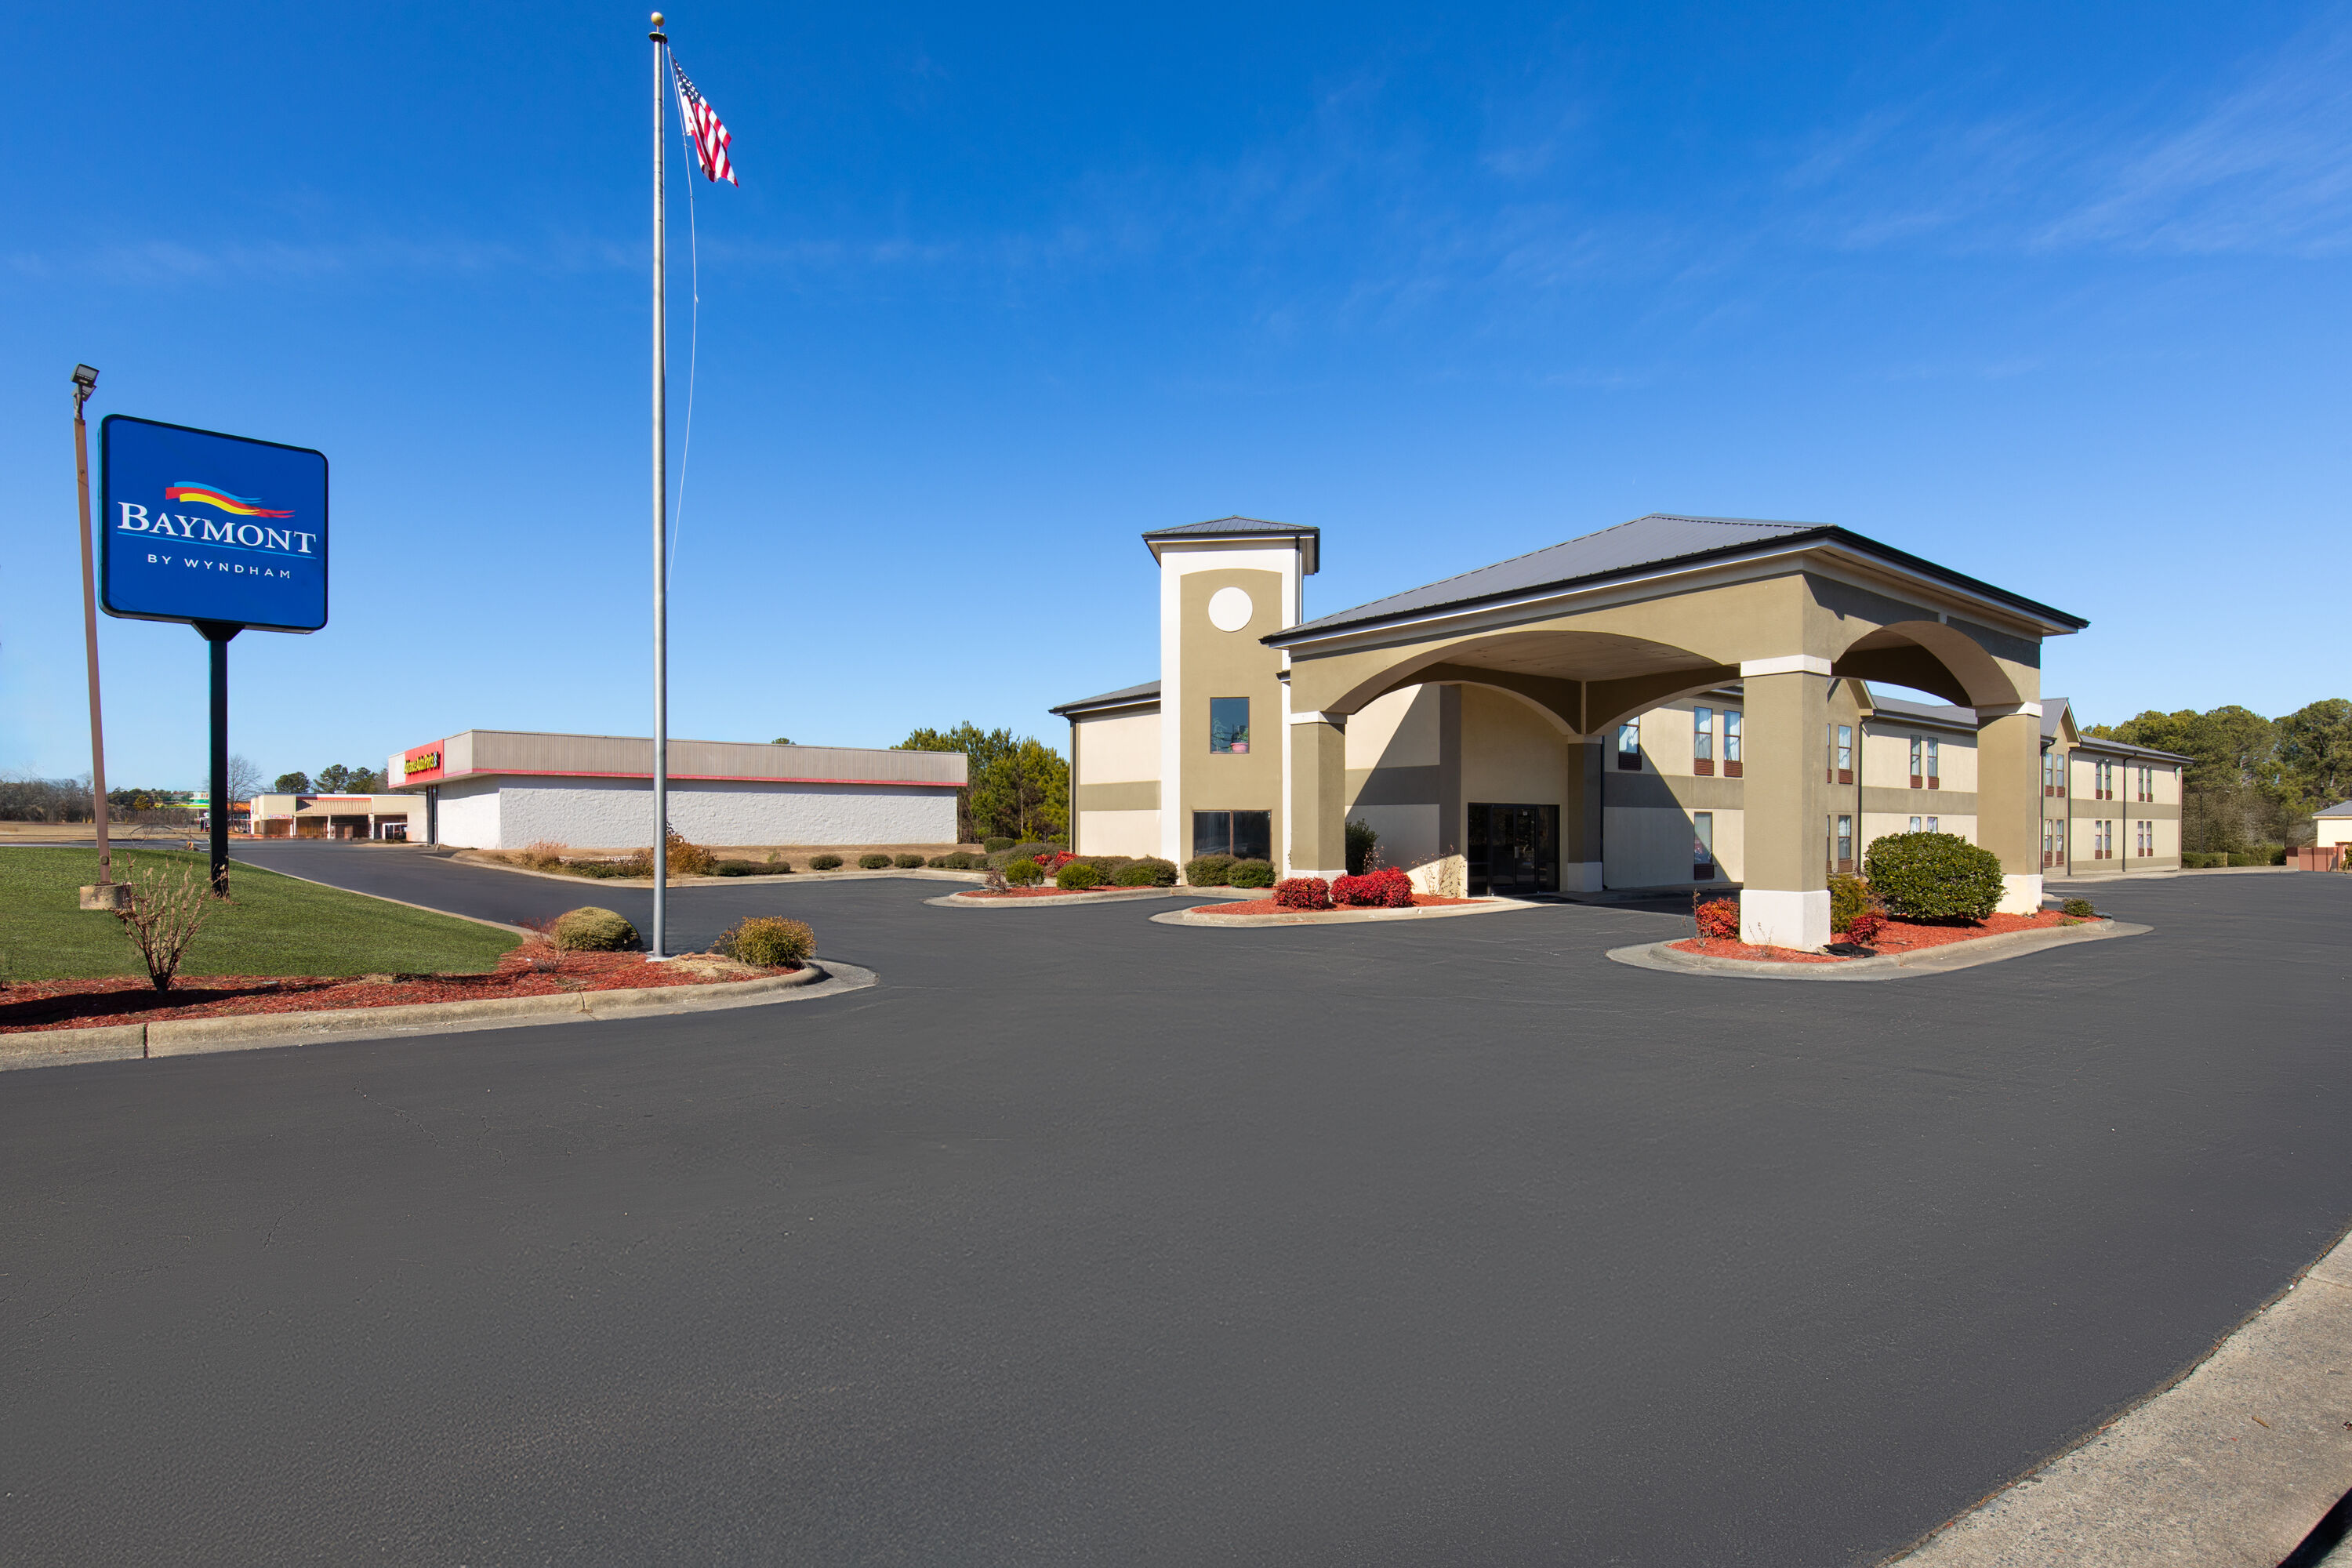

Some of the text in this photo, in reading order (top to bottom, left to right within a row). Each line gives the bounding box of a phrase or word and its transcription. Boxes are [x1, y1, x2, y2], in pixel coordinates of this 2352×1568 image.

[118, 501, 317, 554] BAYMONT
[147, 554, 291, 579] BY WYNDHAM
